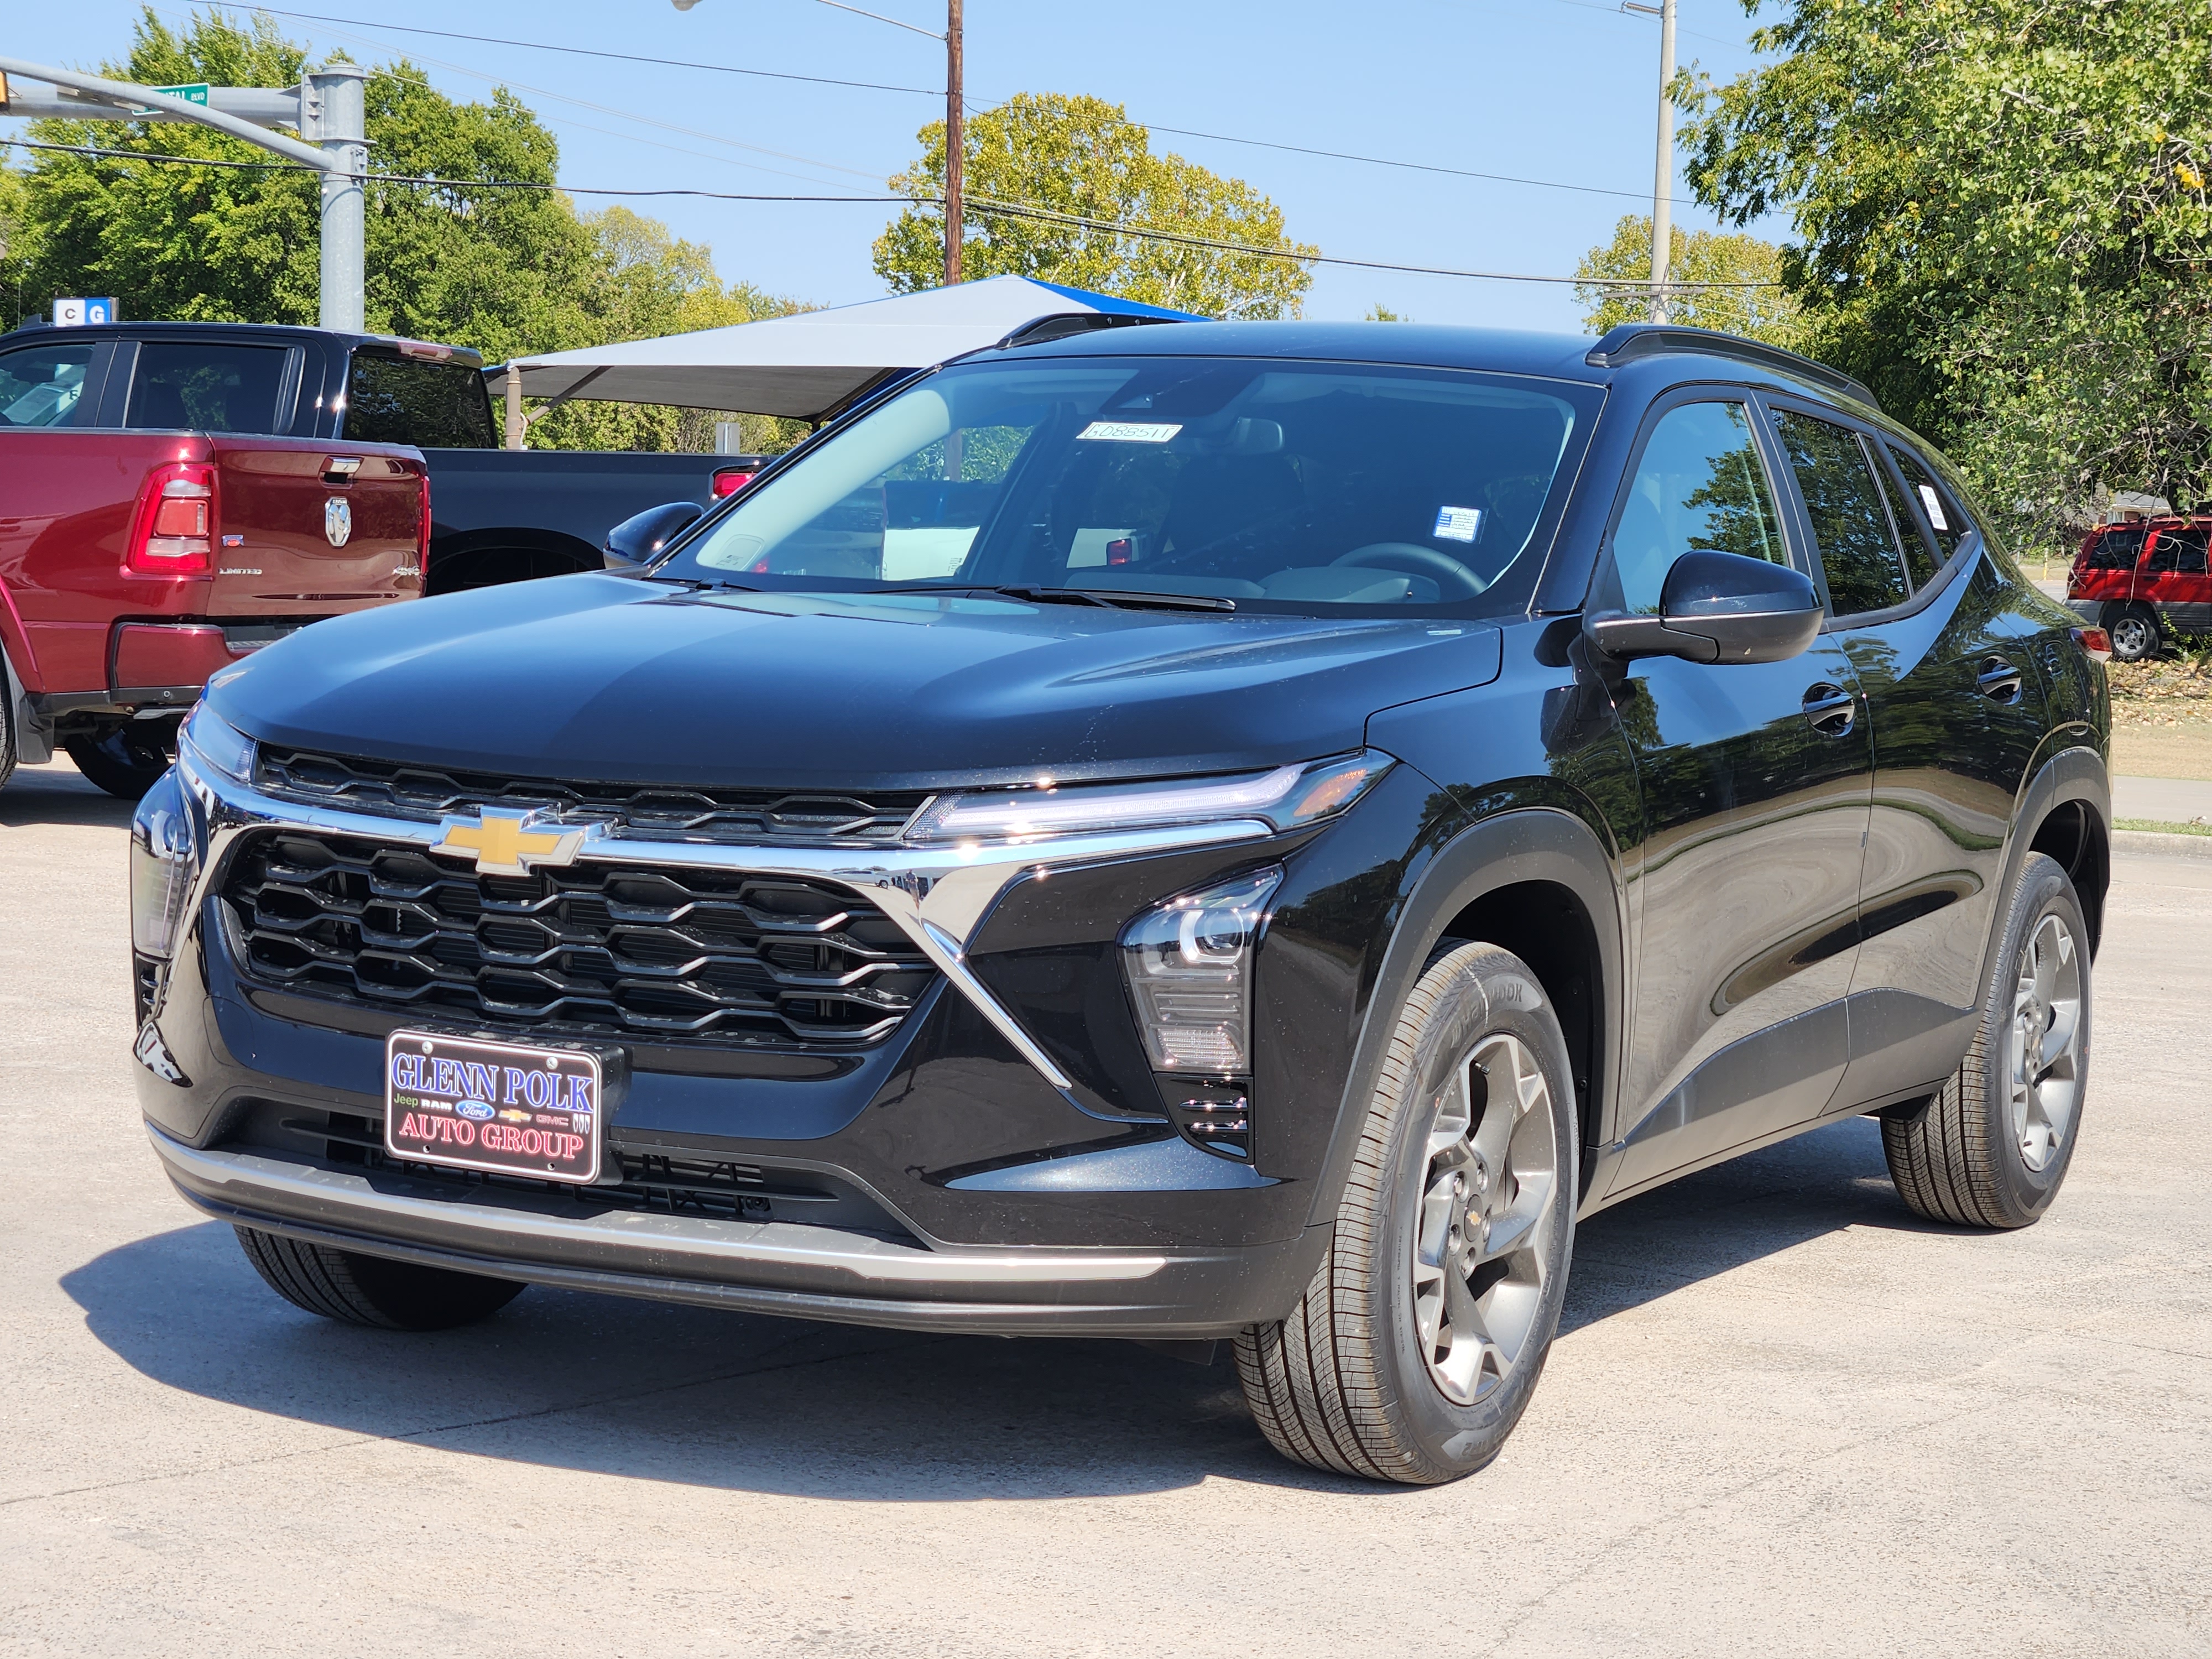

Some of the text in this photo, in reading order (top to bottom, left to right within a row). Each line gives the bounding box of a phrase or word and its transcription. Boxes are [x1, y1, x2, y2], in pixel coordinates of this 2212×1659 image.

[190, 92, 205, 101] BLVD
[65, 305, 105, 324] C G
[392, 1052, 593, 1114] GLENN POLK
[394, 1093, 569, 1126] Jeep RAM Ford GMC
[399, 1112, 584, 1160] AUTO GROUP
